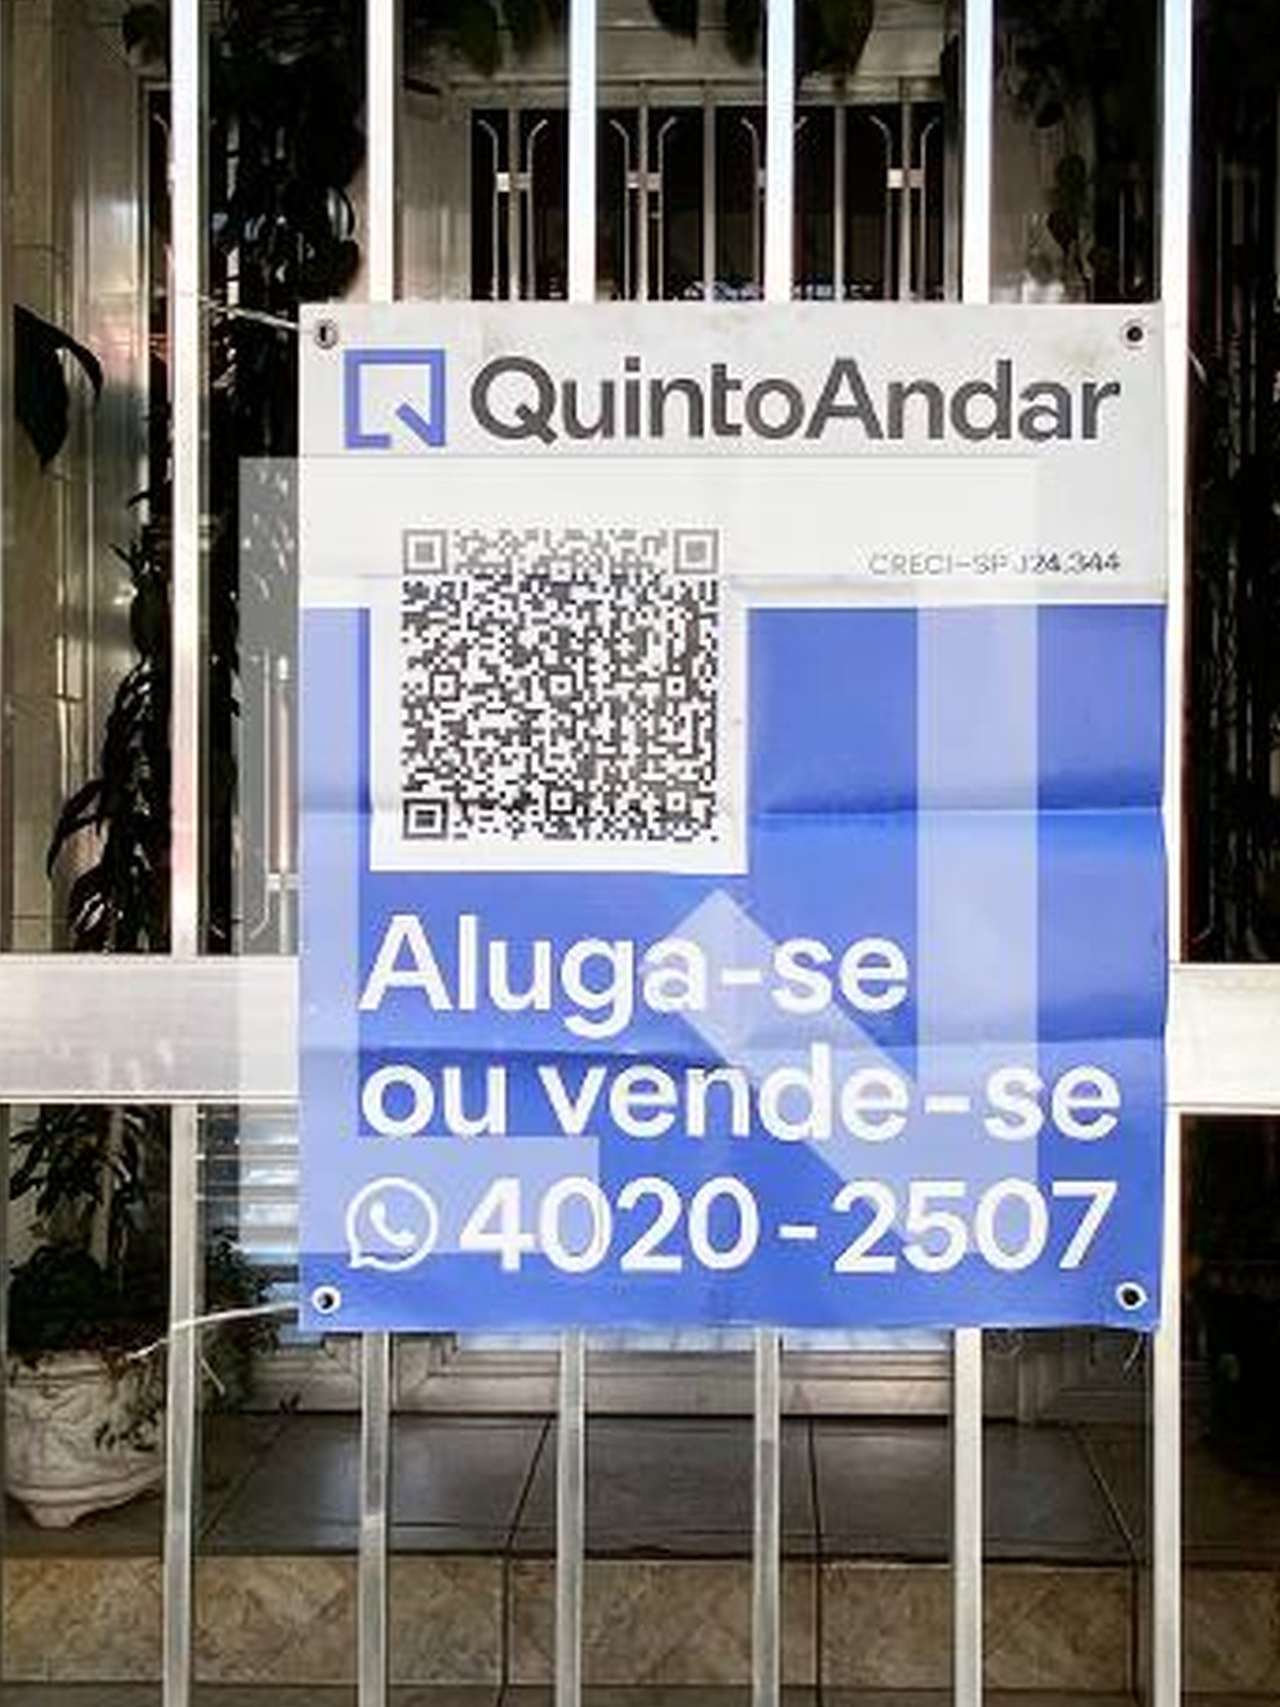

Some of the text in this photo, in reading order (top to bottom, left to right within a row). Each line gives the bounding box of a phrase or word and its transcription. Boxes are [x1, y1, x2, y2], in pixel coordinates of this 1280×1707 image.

[470, 356, 1121, 444] QuintoAndar
[869, 552, 1008, 575] CRECI-SP
[358, 914, 910, 1036] Aluga-se
[360, 1043, 1121, 1142] ou vende-se
